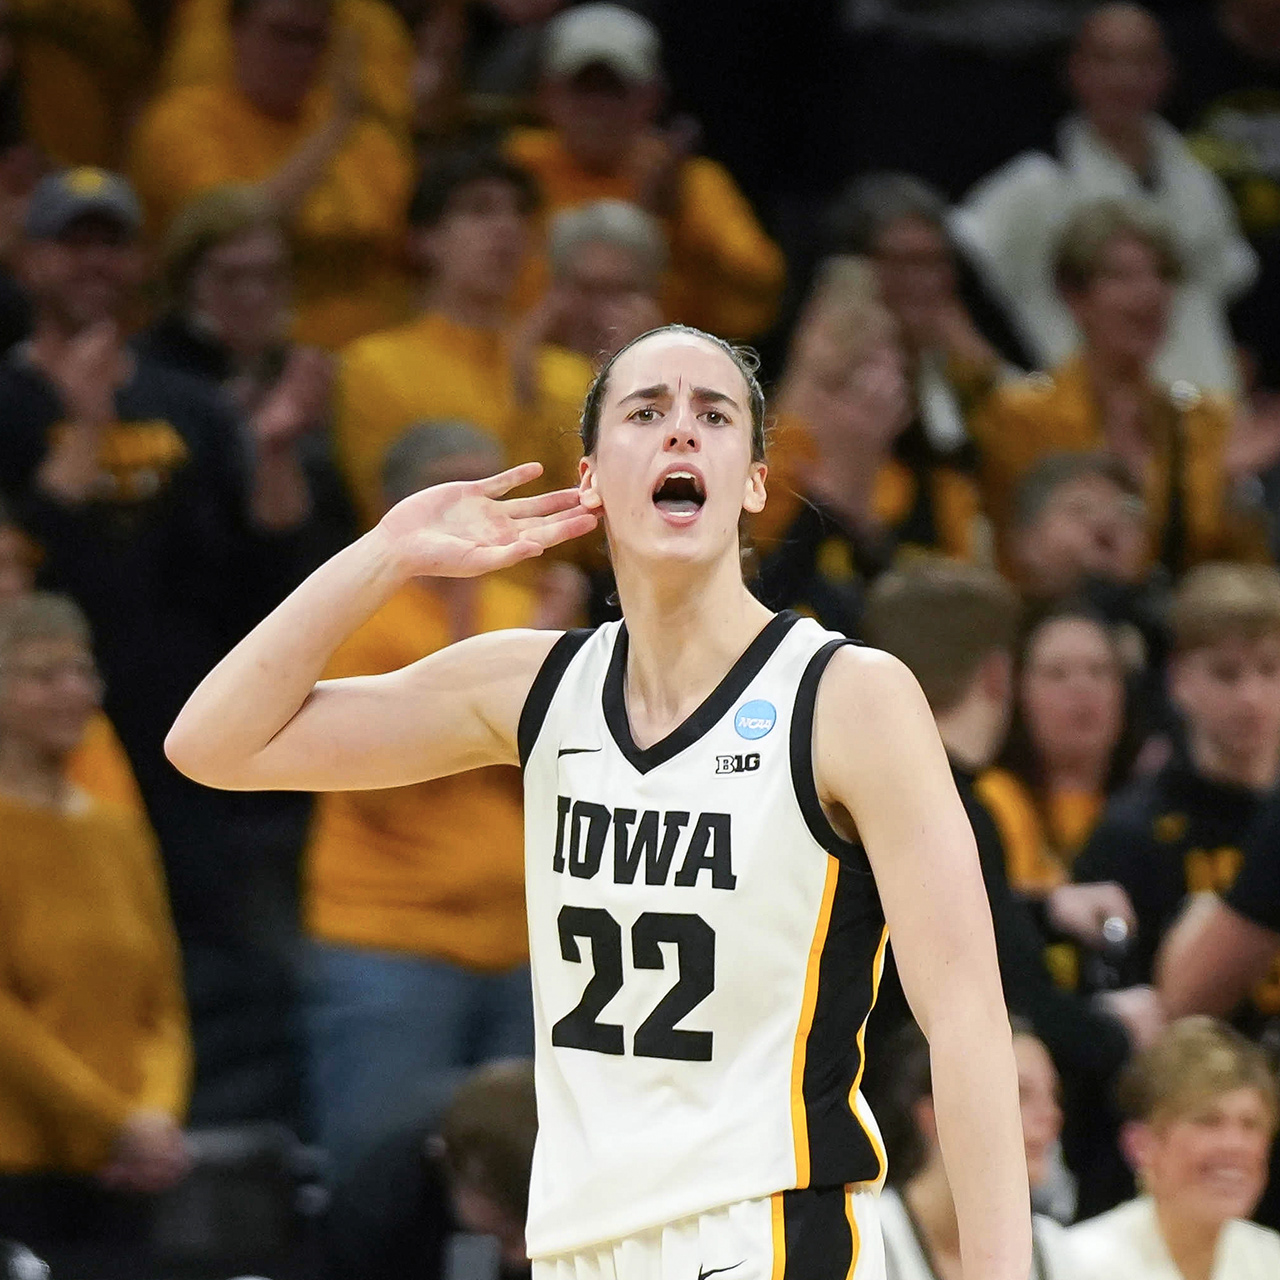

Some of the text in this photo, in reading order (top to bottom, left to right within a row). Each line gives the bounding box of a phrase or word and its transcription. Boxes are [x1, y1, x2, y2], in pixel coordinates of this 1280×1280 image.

[738, 716, 773, 730] NCAA
[553, 795, 737, 890] IOWA
[552, 904, 716, 1062] 22
